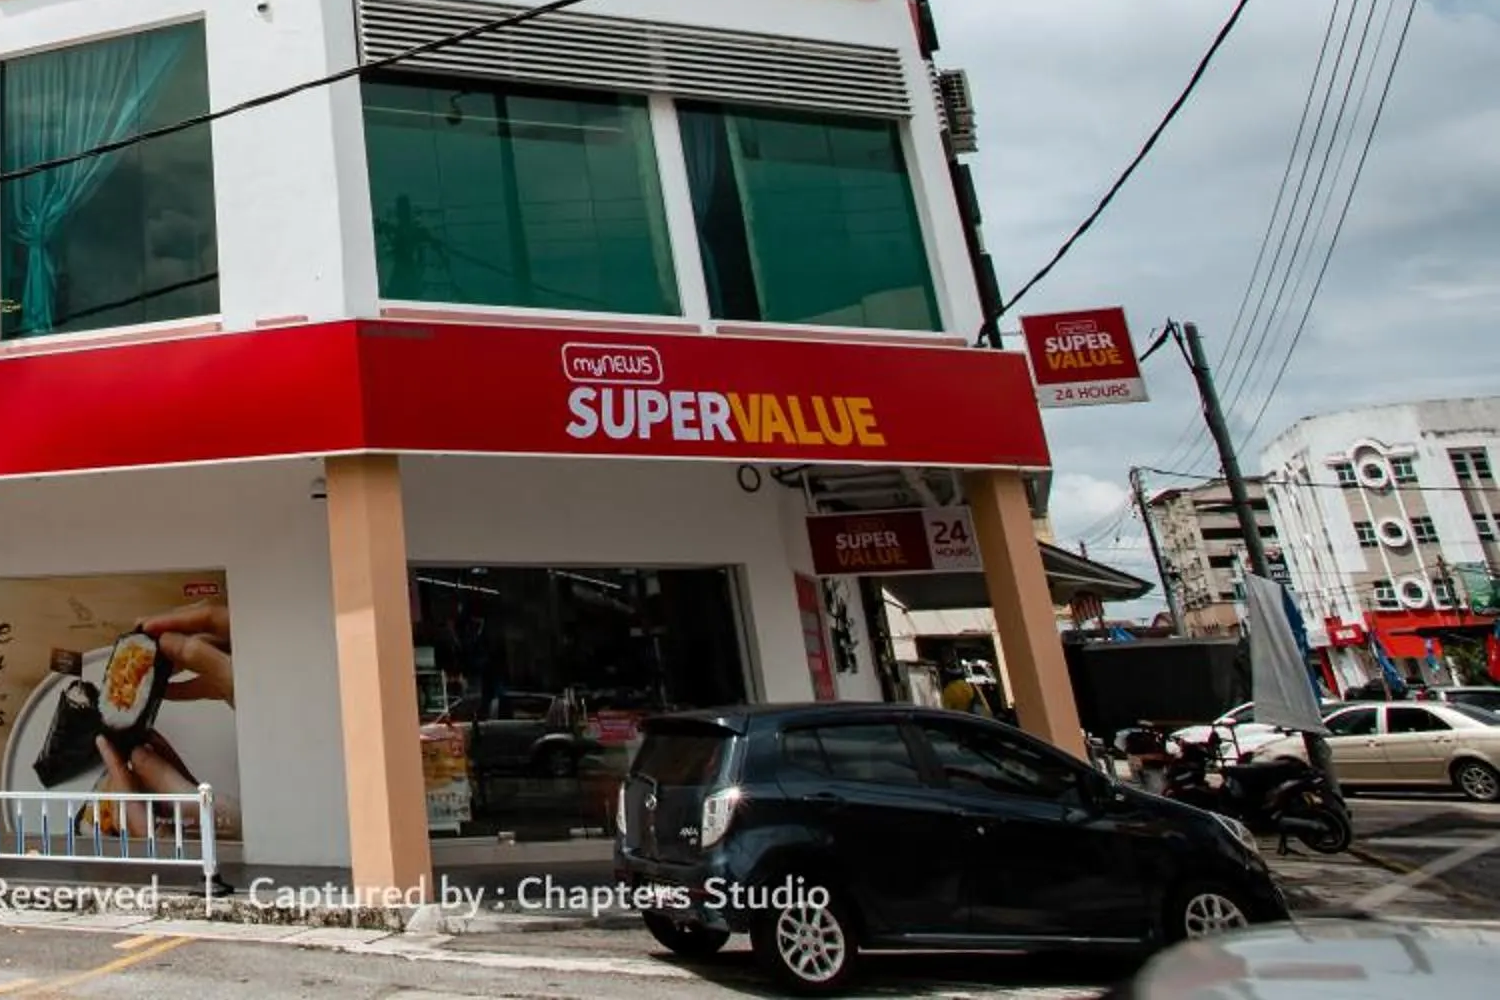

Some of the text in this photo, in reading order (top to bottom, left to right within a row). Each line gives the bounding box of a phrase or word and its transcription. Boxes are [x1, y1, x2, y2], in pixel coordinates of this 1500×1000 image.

[1044, 332, 1115, 353] SUPER
[1045, 349, 1124, 371] VALUE
[1055, 383, 1130, 401] 24 HOURS
[835, 531, 900, 550] SUPER
[930, 520, 968, 544] 24
[836, 548, 908, 566] VALUE
